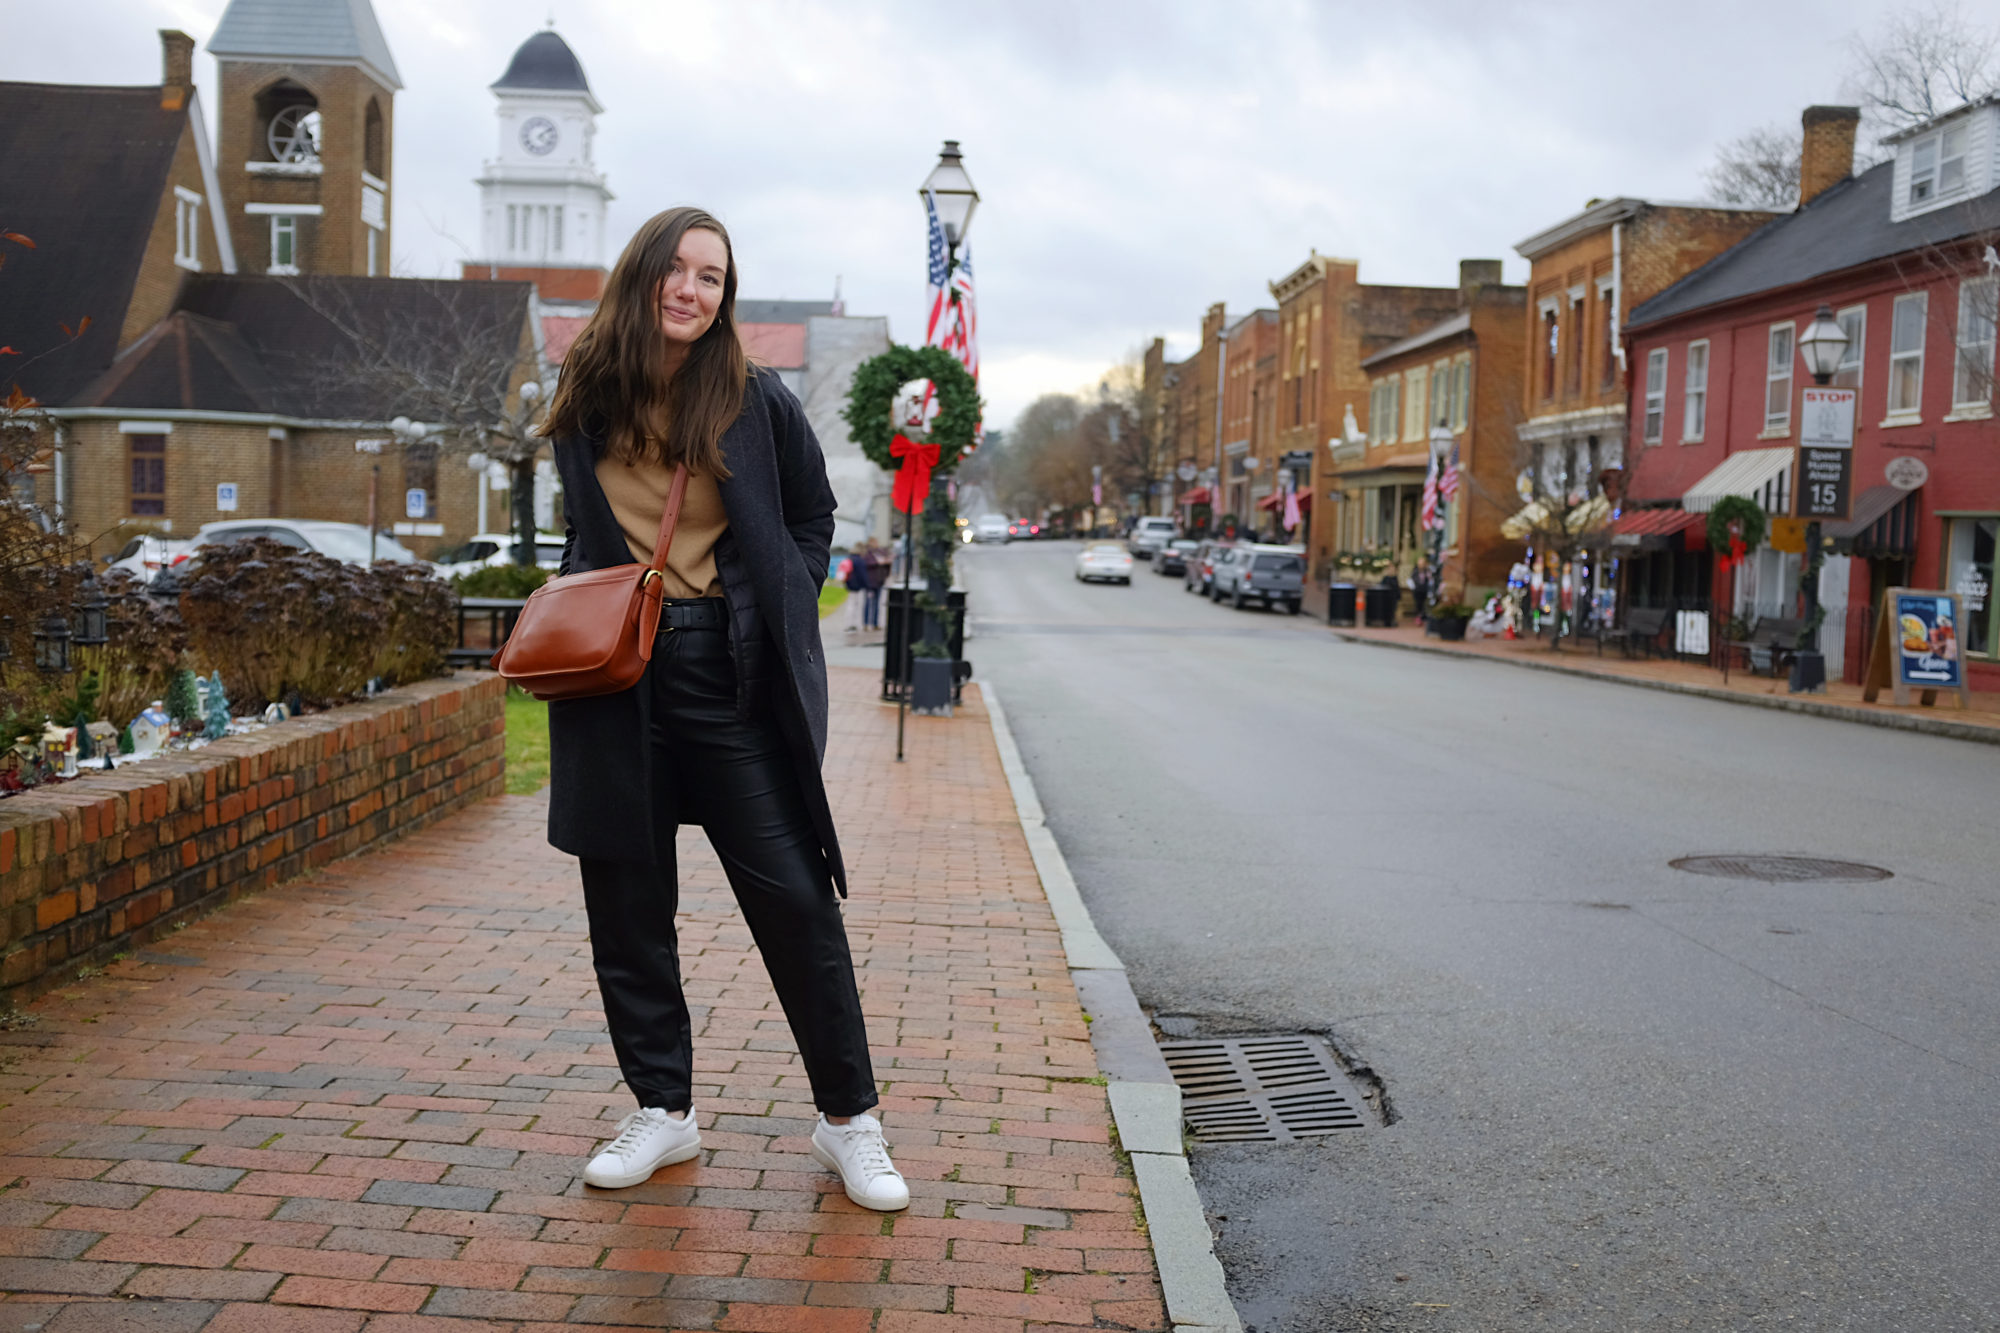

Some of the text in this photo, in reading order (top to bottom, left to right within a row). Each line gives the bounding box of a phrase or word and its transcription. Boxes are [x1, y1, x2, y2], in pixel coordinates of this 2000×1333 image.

[1806, 392, 1853, 403] STOP
[1810, 449, 1842, 461] Speed
[1808, 461, 1843, 472] Humps
[1808, 471, 1841, 481] Ahead
[1810, 484, 1837, 505] 15
